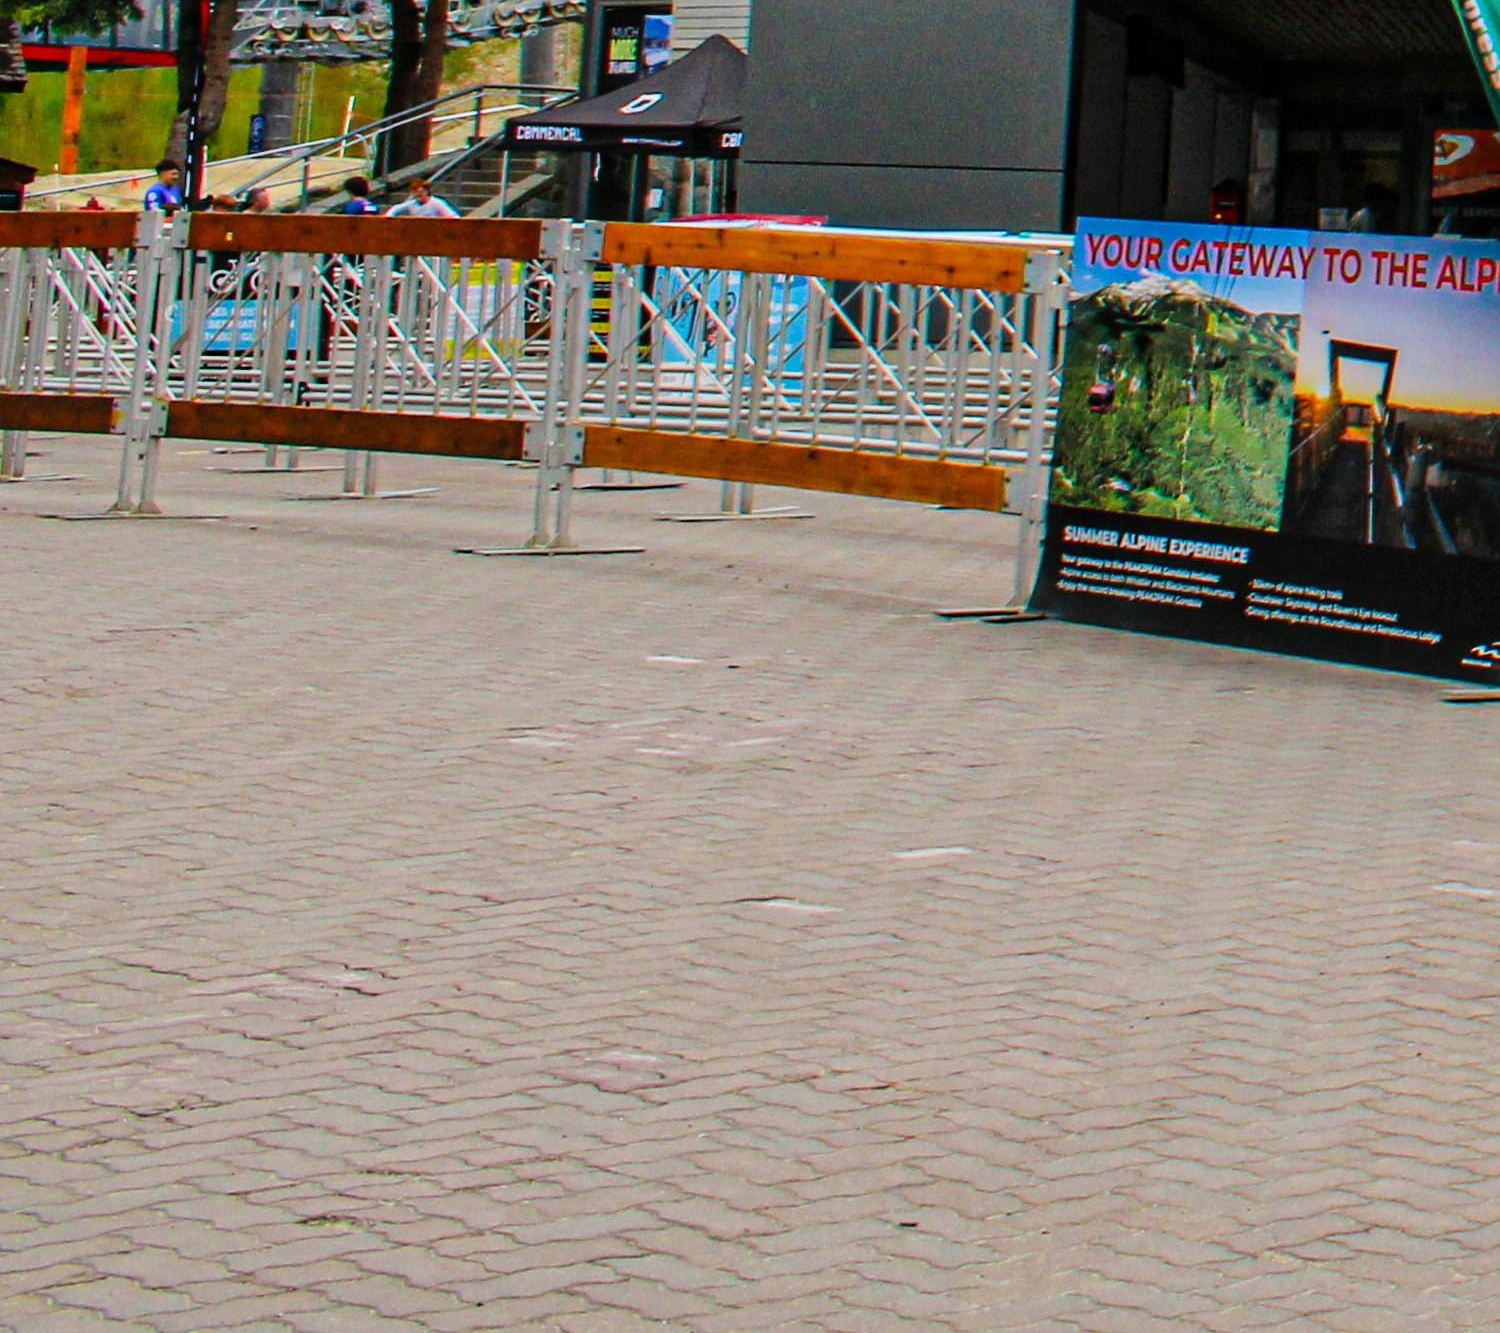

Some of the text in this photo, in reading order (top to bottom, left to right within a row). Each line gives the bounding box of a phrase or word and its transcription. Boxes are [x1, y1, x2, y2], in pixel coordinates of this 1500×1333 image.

[1085, 233, 1162, 270] YOUR
[1173, 237, 1316, 280] GATEWAY
[1323, 247, 1364, 284] TO
[1371, 250, 1428, 290] THE
[1063, 525, 1251, 565] SUMMER ALPINE EXPERIENCE
